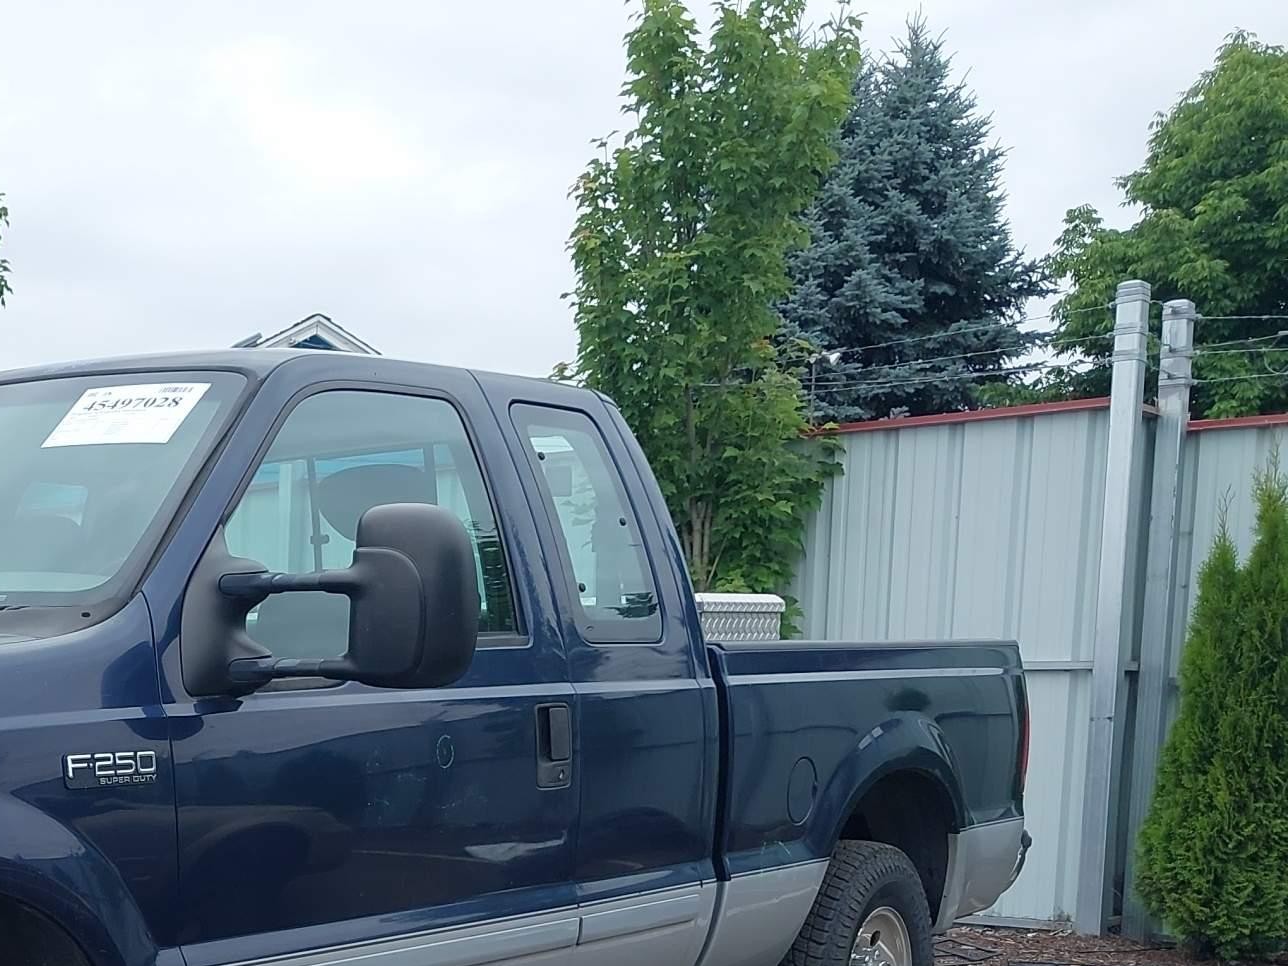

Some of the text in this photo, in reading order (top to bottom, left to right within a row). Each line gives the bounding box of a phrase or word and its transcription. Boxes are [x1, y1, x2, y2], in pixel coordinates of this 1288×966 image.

[83, 396, 183, 411] 45497028
[99, 773, 157, 785] SUPER DUTY
